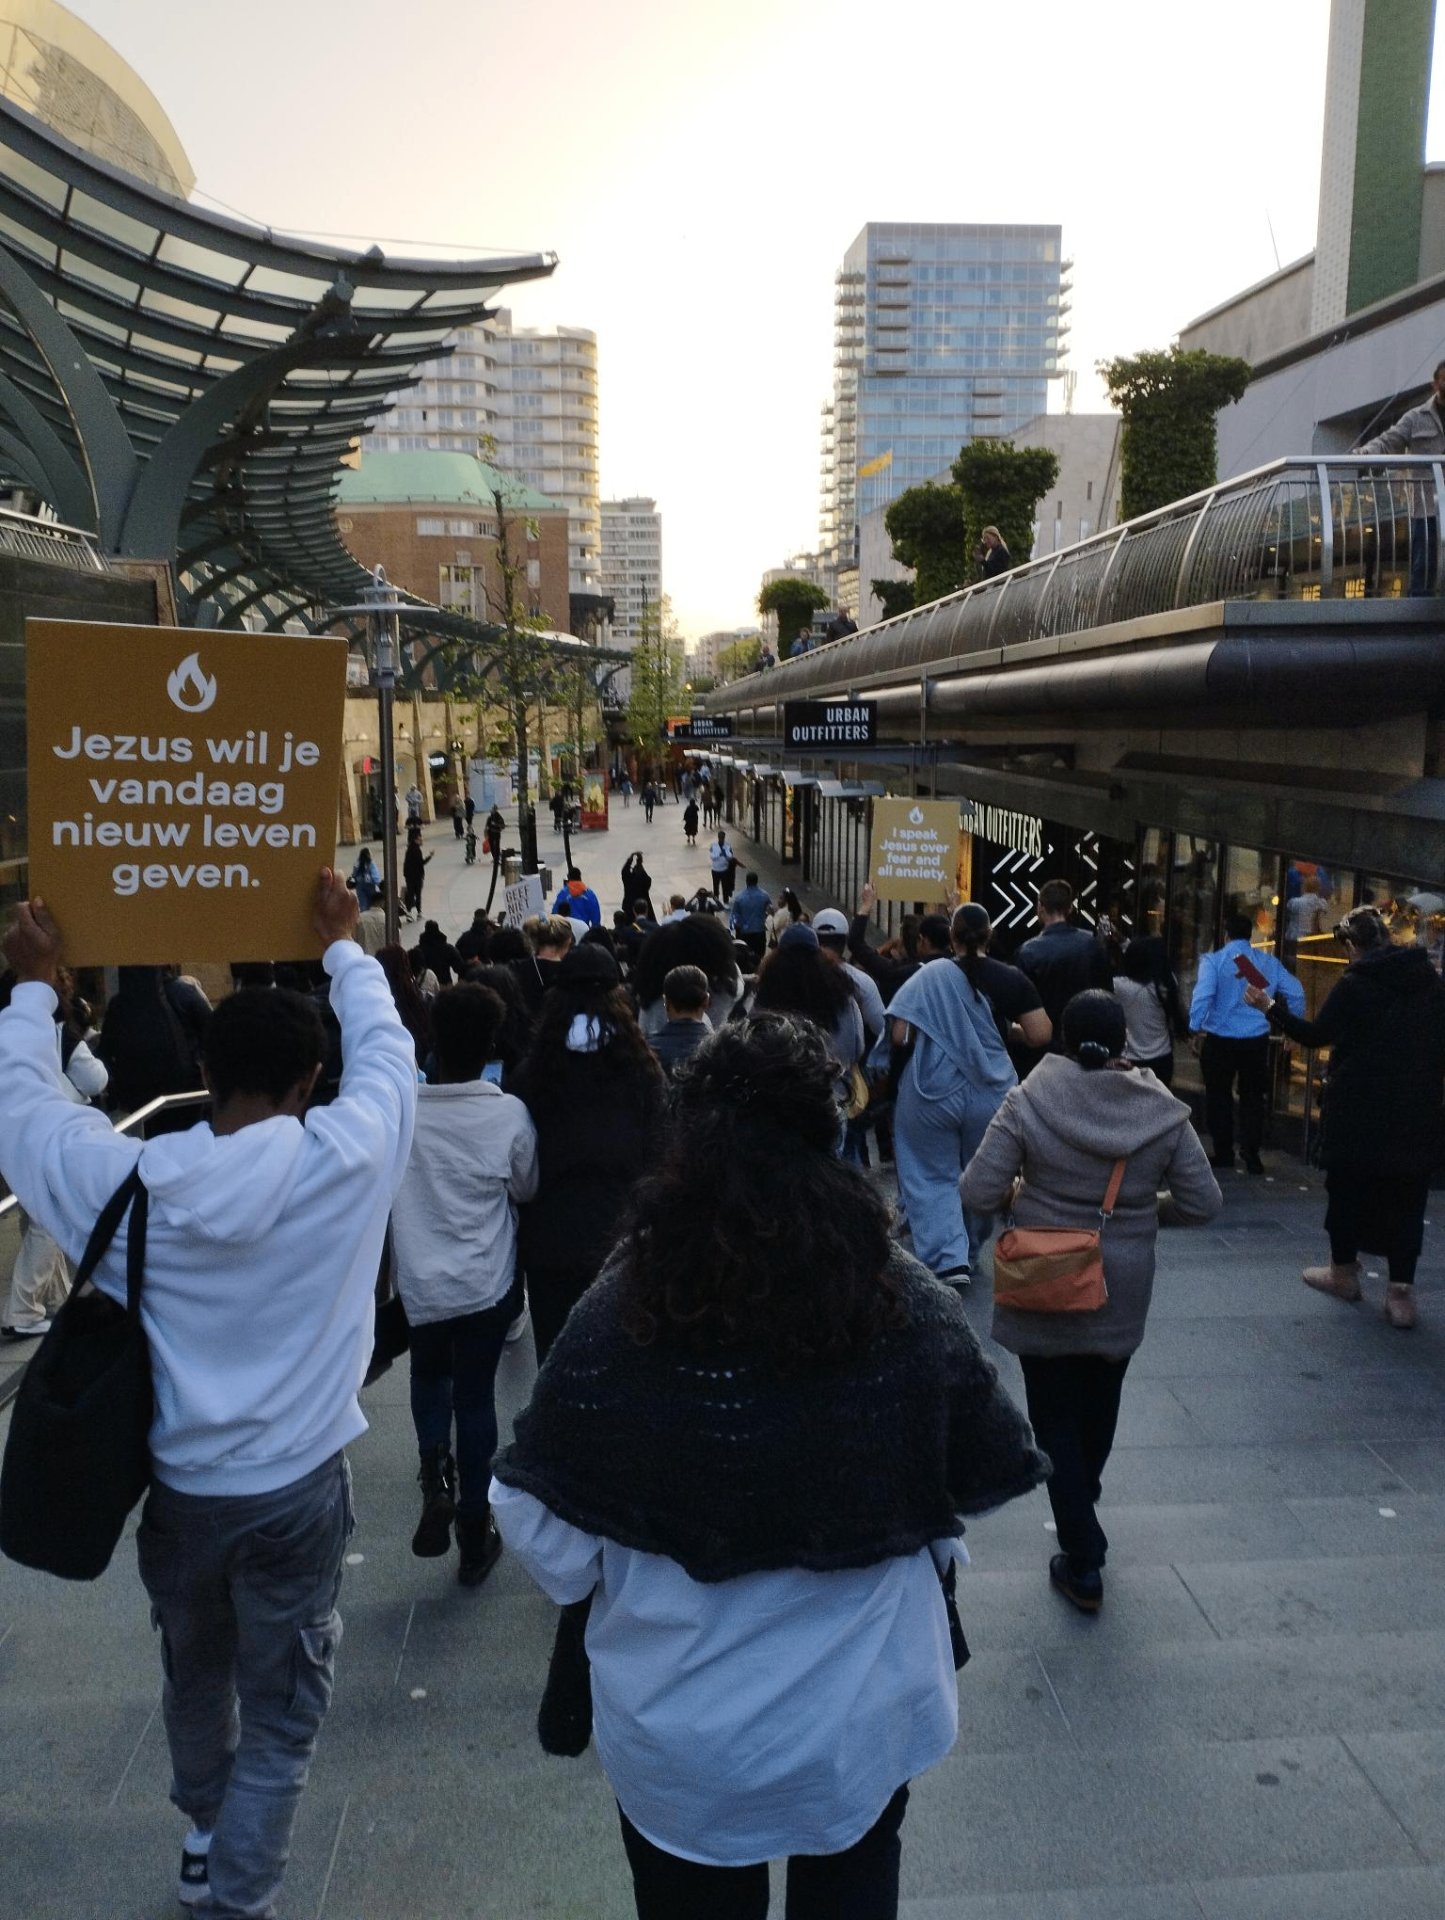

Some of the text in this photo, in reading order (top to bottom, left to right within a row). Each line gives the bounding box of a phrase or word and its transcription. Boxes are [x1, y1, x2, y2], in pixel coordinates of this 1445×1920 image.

[826, 707, 870, 723] URBAN
[792, 724, 870, 742] OUTFITTERS
[52, 726, 321, 773] Jezus wil je
[89, 772, 285, 814] vandaag
[52, 813, 316, 848] nieuw leven
[892, 827, 938, 841] I speak
[986, 805, 1043, 859] OUTFITTERS
[880, 840, 950, 854] Jesus over
[887, 852, 940, 867] fear and
[111, 863, 261, 897] geven.
[877, 865, 948, 882] all anxiety.
